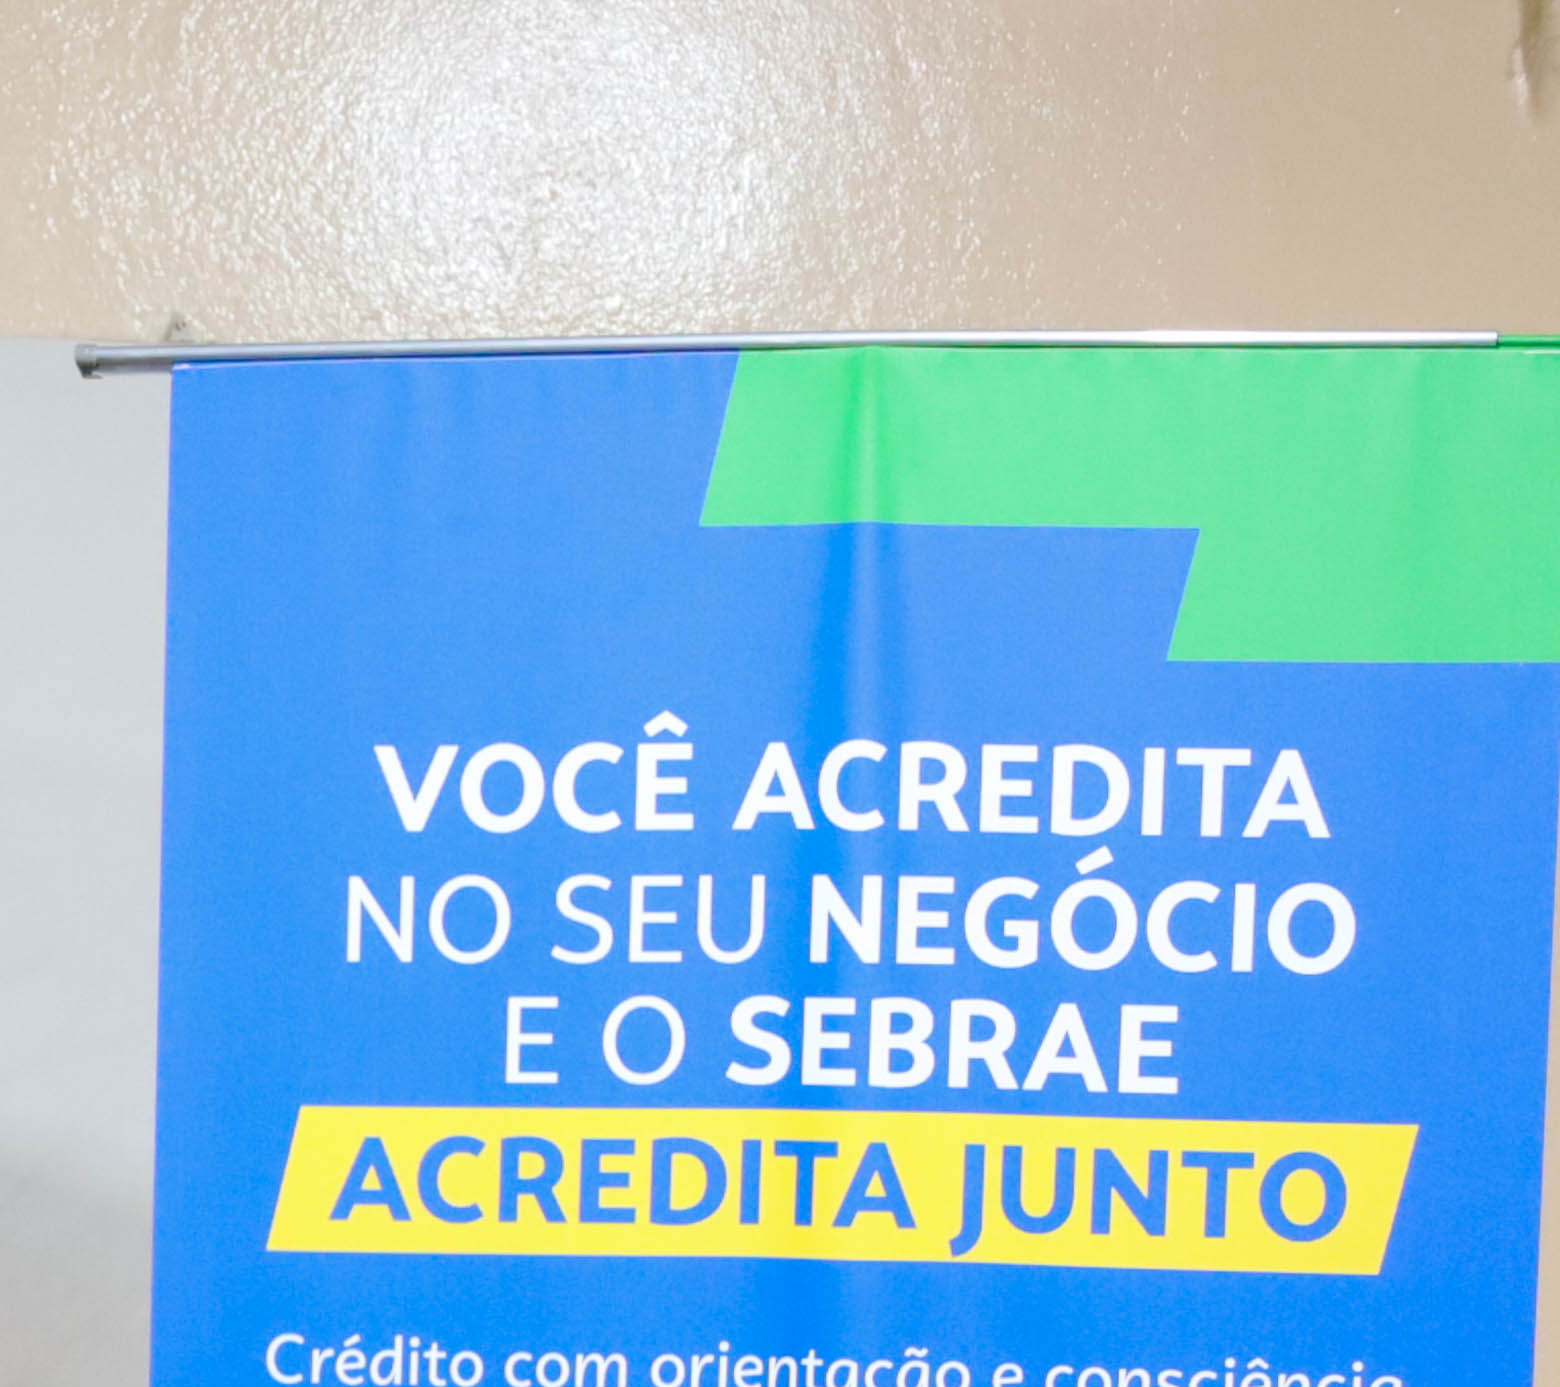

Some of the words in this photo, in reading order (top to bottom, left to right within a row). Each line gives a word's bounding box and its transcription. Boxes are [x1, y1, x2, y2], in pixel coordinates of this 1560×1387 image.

[373, 709, 695, 834] VOCÊ
[731, 738, 1331, 839] ACREDITA
[346, 874, 512, 965] NO
[550, 873, 766, 965] SEU
[809, 845, 1357, 976] NEGÓCIO
[505, 995, 560, 1084] E
[602, 994, 686, 1086] O
[725, 994, 1180, 1095] SEBRAE
[331, 1135, 916, 1228] ACREDITA
[950, 1144, 1347, 1256] JUNTO
